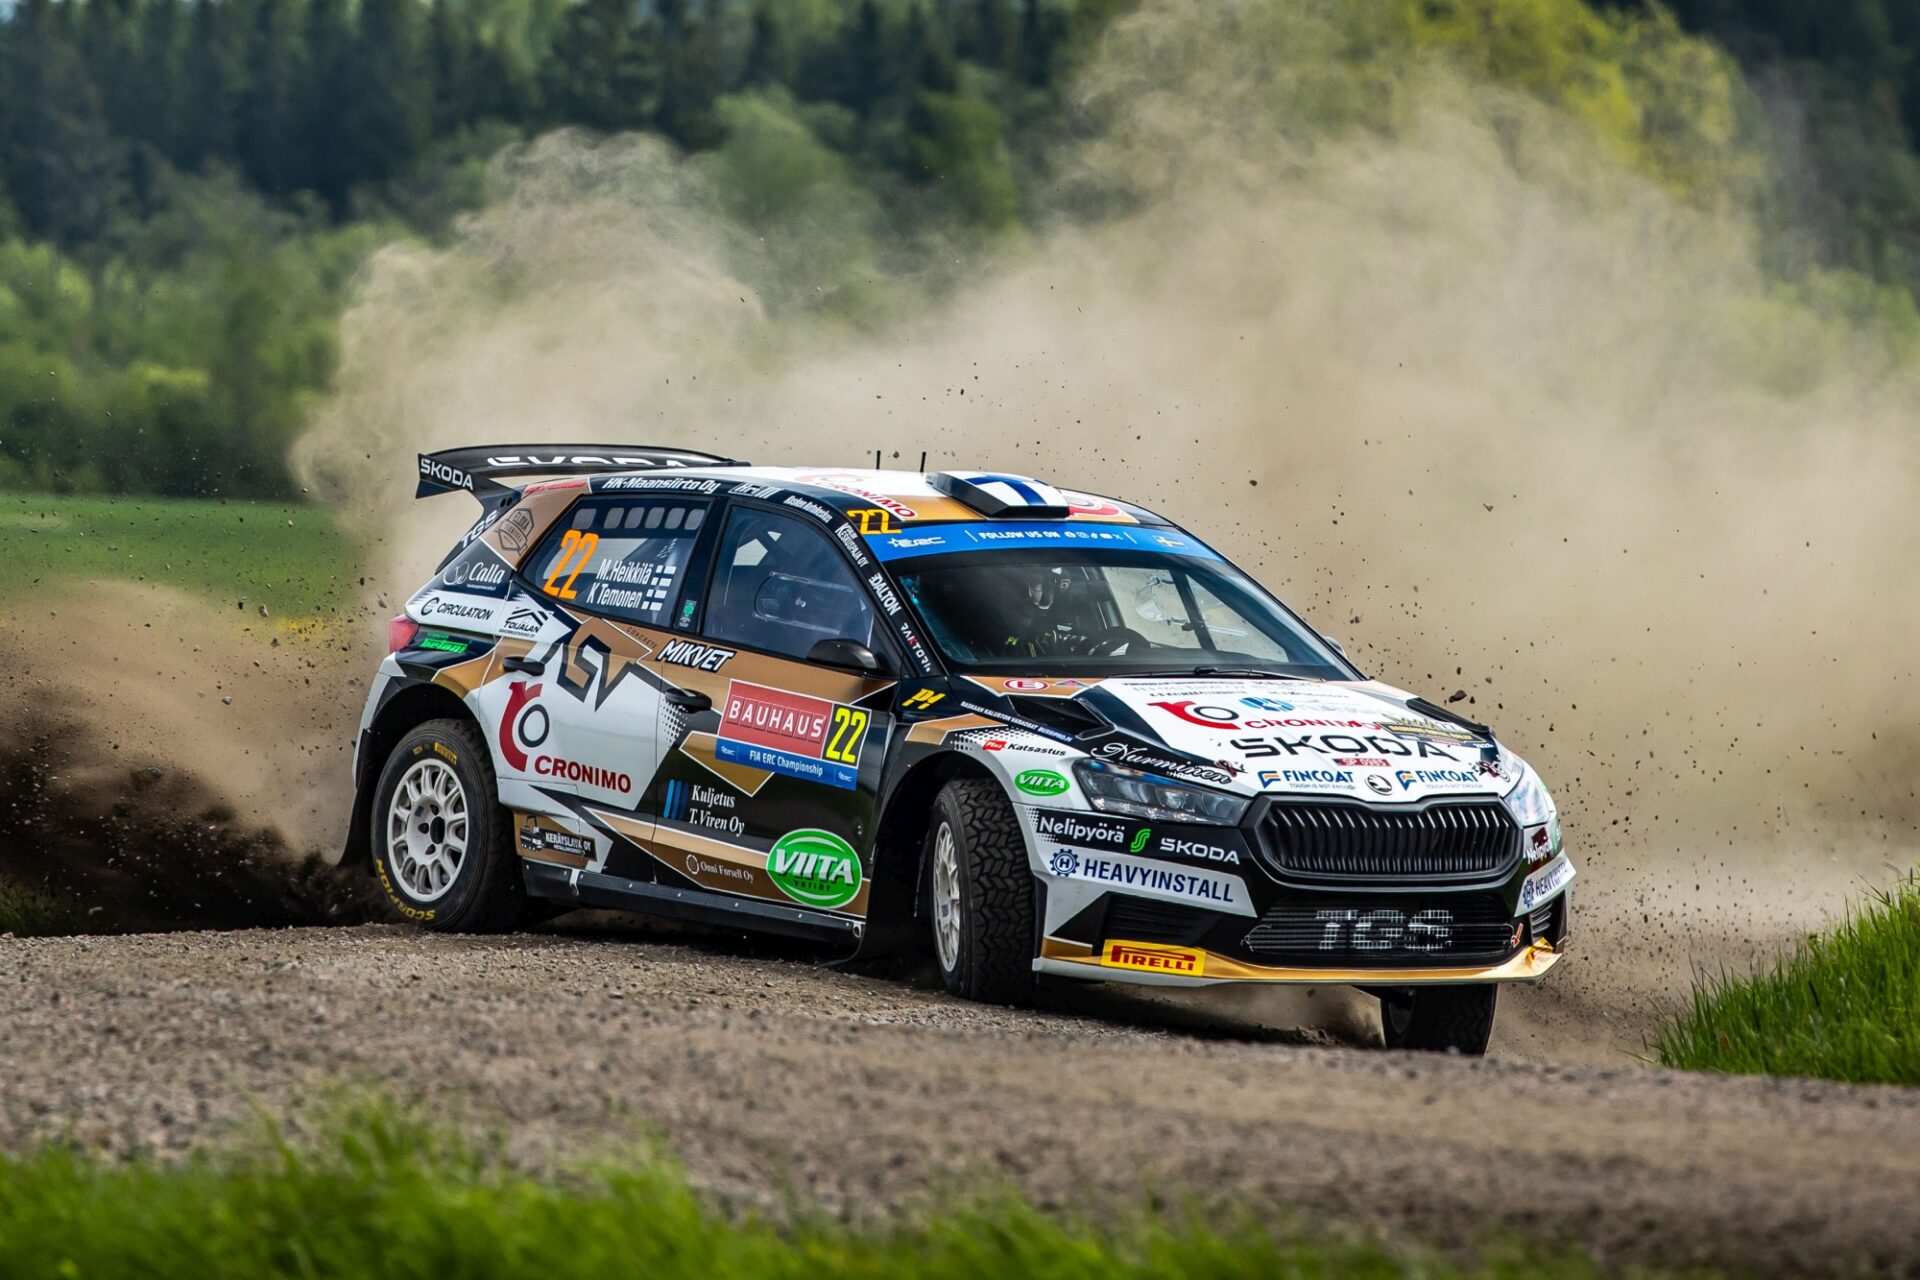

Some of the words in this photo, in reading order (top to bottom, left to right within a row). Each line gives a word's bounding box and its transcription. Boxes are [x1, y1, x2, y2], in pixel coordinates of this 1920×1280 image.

[602, 477, 698, 490] HK-Maansiirto
[698, 480, 721, 494] Oy
[461, 509, 498, 548] TGS
[847, 508, 902, 535] 22
[978, 531, 1024, 540] FOLLOW
[1025, 531, 1043, 539] US
[1043, 530, 1061, 538] ON
[468, 562, 506, 584] Calla
[543, 529, 599, 600] 22
[596, 559, 653, 585] M.Heikkilä
[586, 583, 599, 603] K
[598, 584, 643, 609] Temonen
[436, 602, 494, 621] CIRCULATION
[656, 638, 737, 672] MIKVET
[728, 699, 826, 738] BAUHAUS
[825, 707, 867, 764] 22
[1244, 718, 1384, 731] CRONIMO
[1007, 743, 1067, 756] Katsastus
[1230, 735, 1462, 762] SKODA
[534, 755, 631, 793] CRONIMO
[749, 750, 761, 762] FIA
[762, 753, 776, 766] ERC
[777, 756, 824, 778] Championship
[1090, 742, 1232, 785] Nurminen
[1282, 770, 1354, 783] FINCOAT
[1415, 770, 1479, 783] FINCOAT
[1019, 774, 1066, 789] VIITA
[691, 784, 735, 808] Kuljetus
[689, 808, 728, 831] T.Viren
[729, 816, 745, 838] Oy
[1039, 817, 1125, 843] Nelipyörä
[1160, 837, 1240, 865] SKODA
[700, 861, 718, 875] Onni
[718, 865, 743, 880] Forsell
[743, 870, 754, 883] Oy
[774, 848, 854, 885] VIITA
[1083, 858, 1234, 903] HEAVYINSTALL
[1111, 945, 1196, 971] PIRELLI
